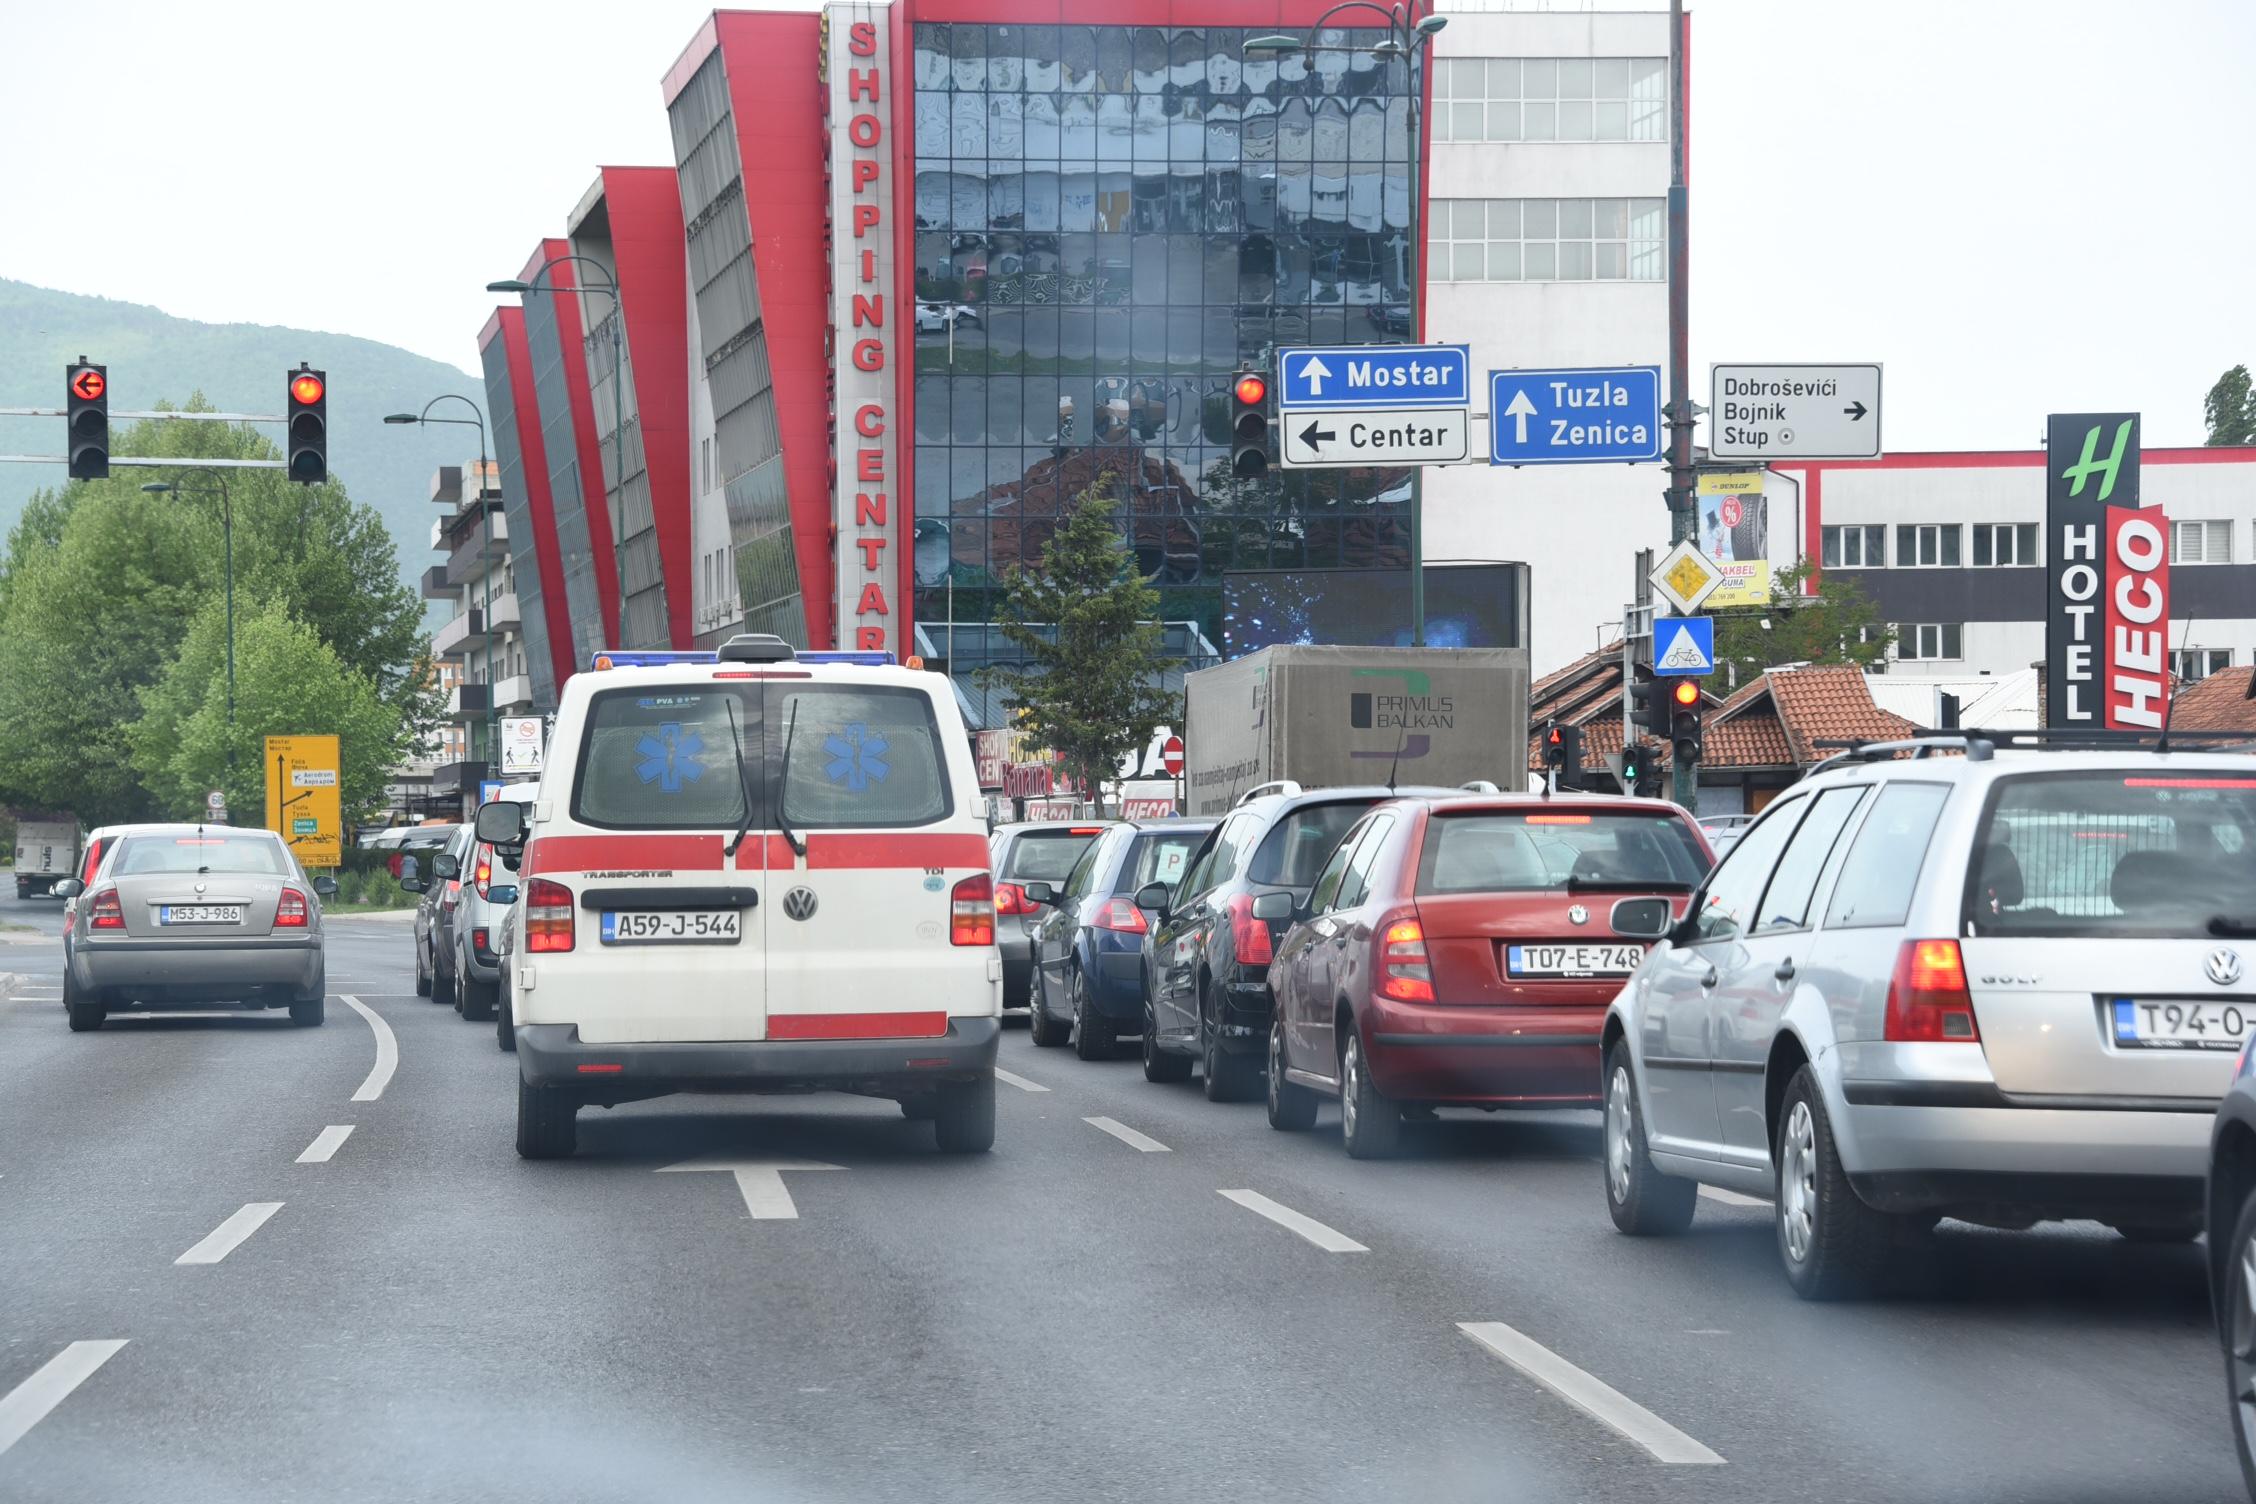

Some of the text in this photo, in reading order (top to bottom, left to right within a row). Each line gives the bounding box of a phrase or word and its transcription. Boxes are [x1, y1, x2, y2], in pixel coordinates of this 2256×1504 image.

[848, 22, 889, 650] SHOPPING CENTAR
[1348, 361, 1453, 387] Mostar
[1550, 381, 1629, 408] Tuzla
[1724, 378, 1837, 396] Dobroševići
[1724, 402, 1787, 425] Bojnik
[1350, 423, 1449, 449] Centar
[1550, 419, 1648, 446] Zenica
[1724, 426, 1769, 449] Stup
[2060, 523, 2099, 721] HOTEL
[2113, 518, 2164, 730] HECO
[1377, 696, 1453, 712] PRIMUS
[1377, 714, 1453, 729] BALKAN
[1001, 761, 1047, 798] Banana
[1168, 853, 1181, 870] P
[582, 870, 674, 879] TRANSPORTER
[170, 907, 238, 921] M53-J-986
[618, 914, 737, 937] A59-J-544
[1524, 947, 1641, 969] T07-E-748
